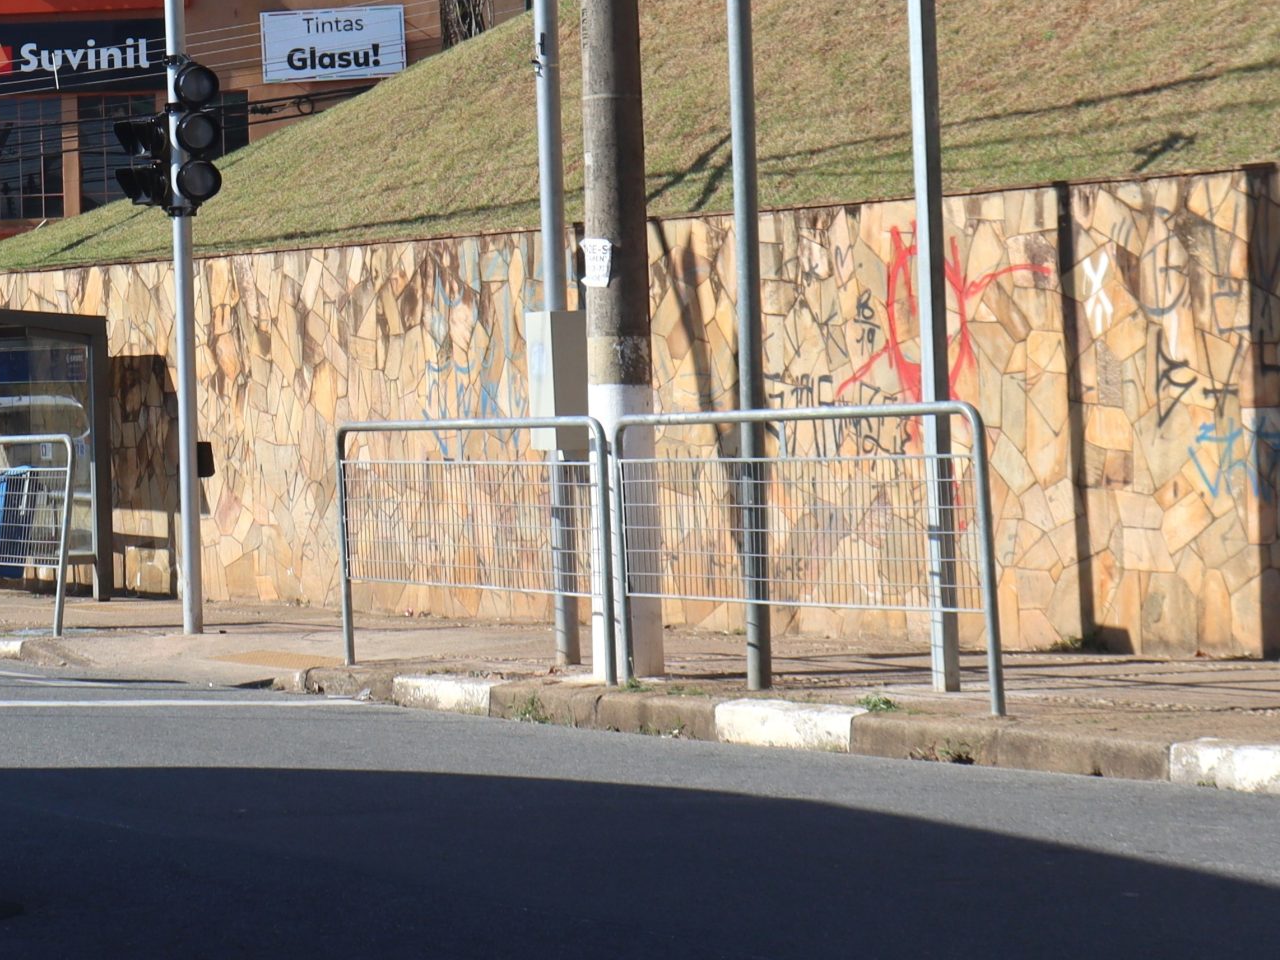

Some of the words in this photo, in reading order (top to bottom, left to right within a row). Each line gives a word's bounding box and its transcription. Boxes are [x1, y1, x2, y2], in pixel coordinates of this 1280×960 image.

[302, 16, 365, 34] Tintas
[19, 37, 150, 73] Suvinil
[287, 43, 381, 71] Glasu!
